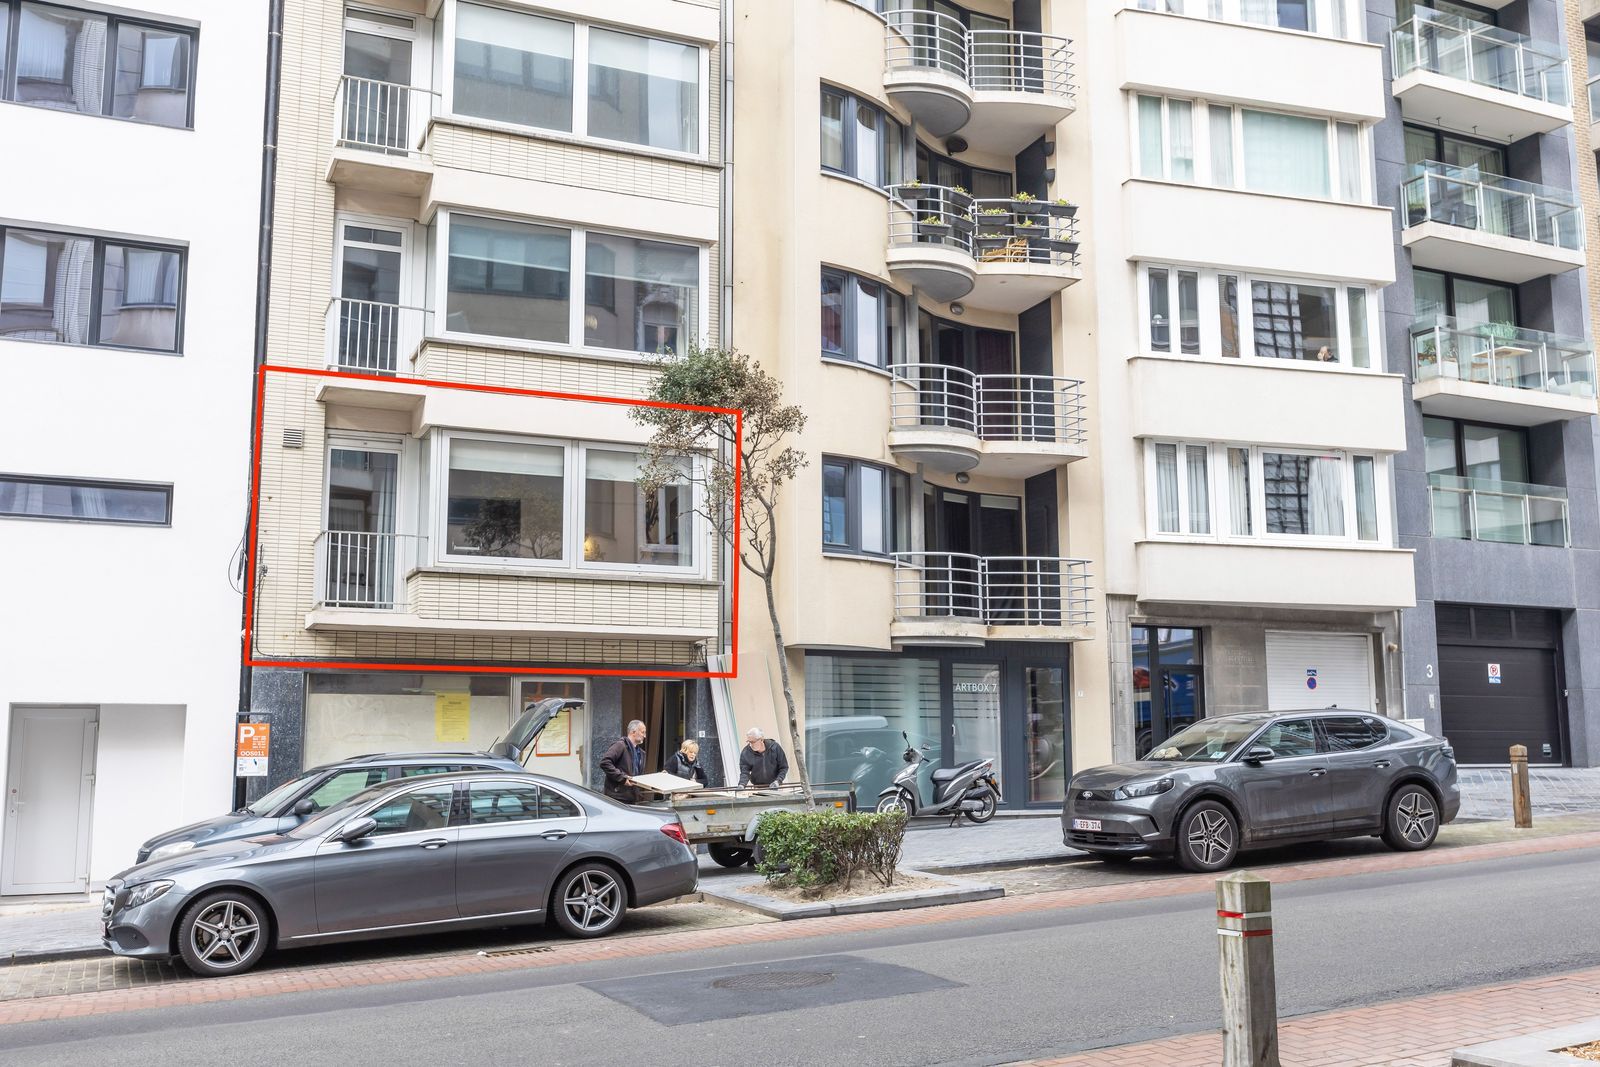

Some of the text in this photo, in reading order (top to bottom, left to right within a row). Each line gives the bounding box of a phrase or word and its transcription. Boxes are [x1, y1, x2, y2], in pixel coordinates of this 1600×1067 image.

[1426, 664, 1433, 678] 3
[955, 683, 997, 692] ARTBOX 7
[240, 726, 255, 743] P
